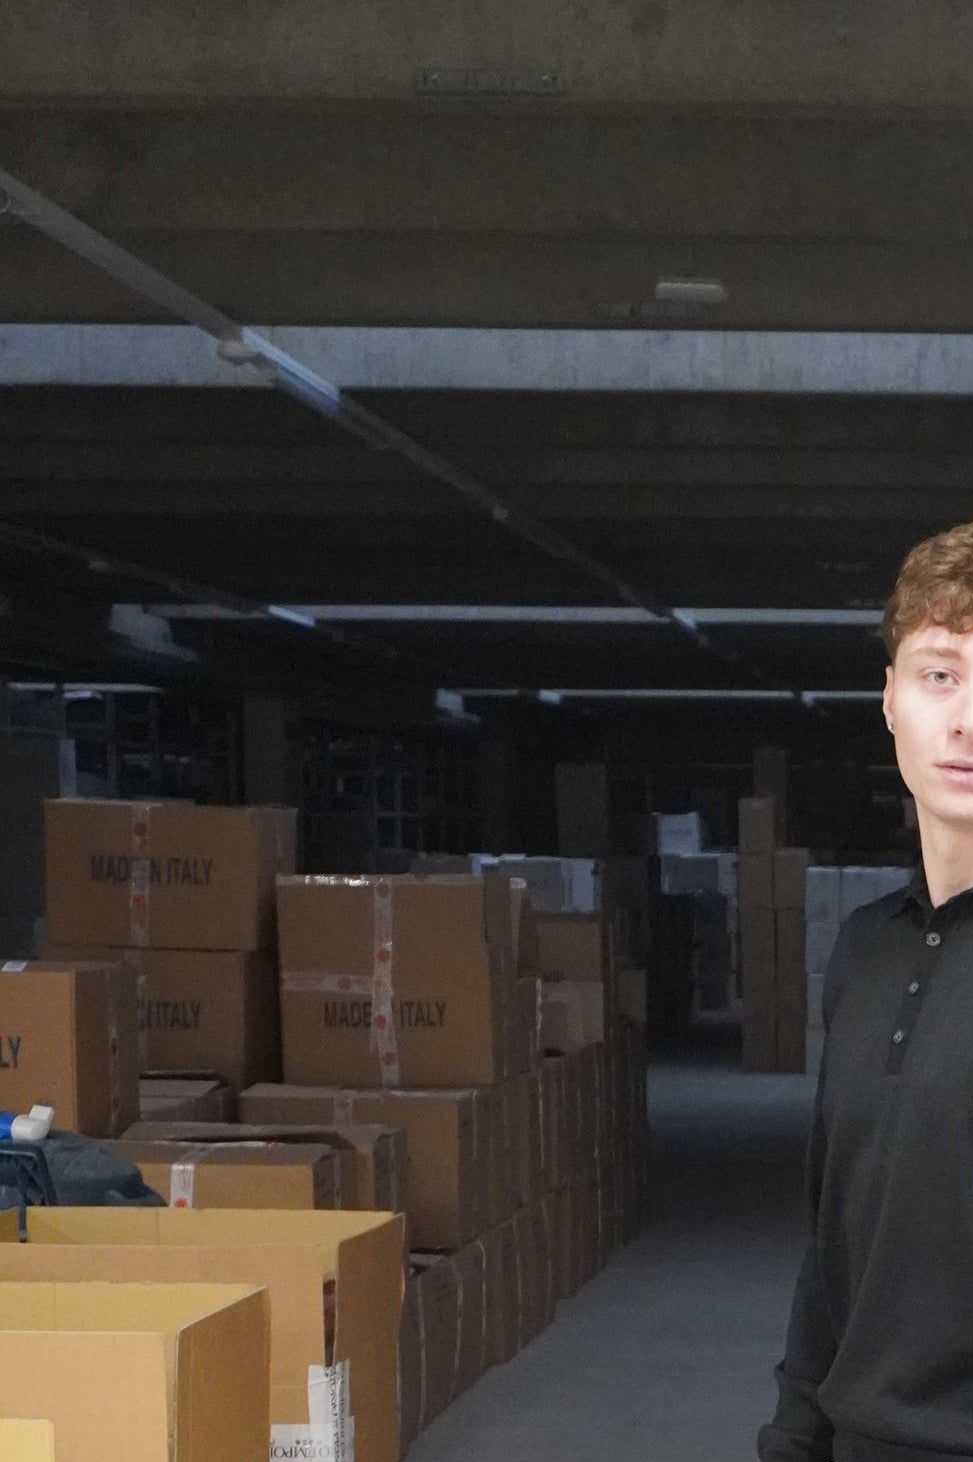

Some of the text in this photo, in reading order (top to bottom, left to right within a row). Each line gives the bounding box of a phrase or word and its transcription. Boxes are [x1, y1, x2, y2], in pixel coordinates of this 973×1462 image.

[166, 857, 215, 886] ITALY
[323, 1001, 373, 1028] MADE
[399, 1000, 447, 1028] ITALY
